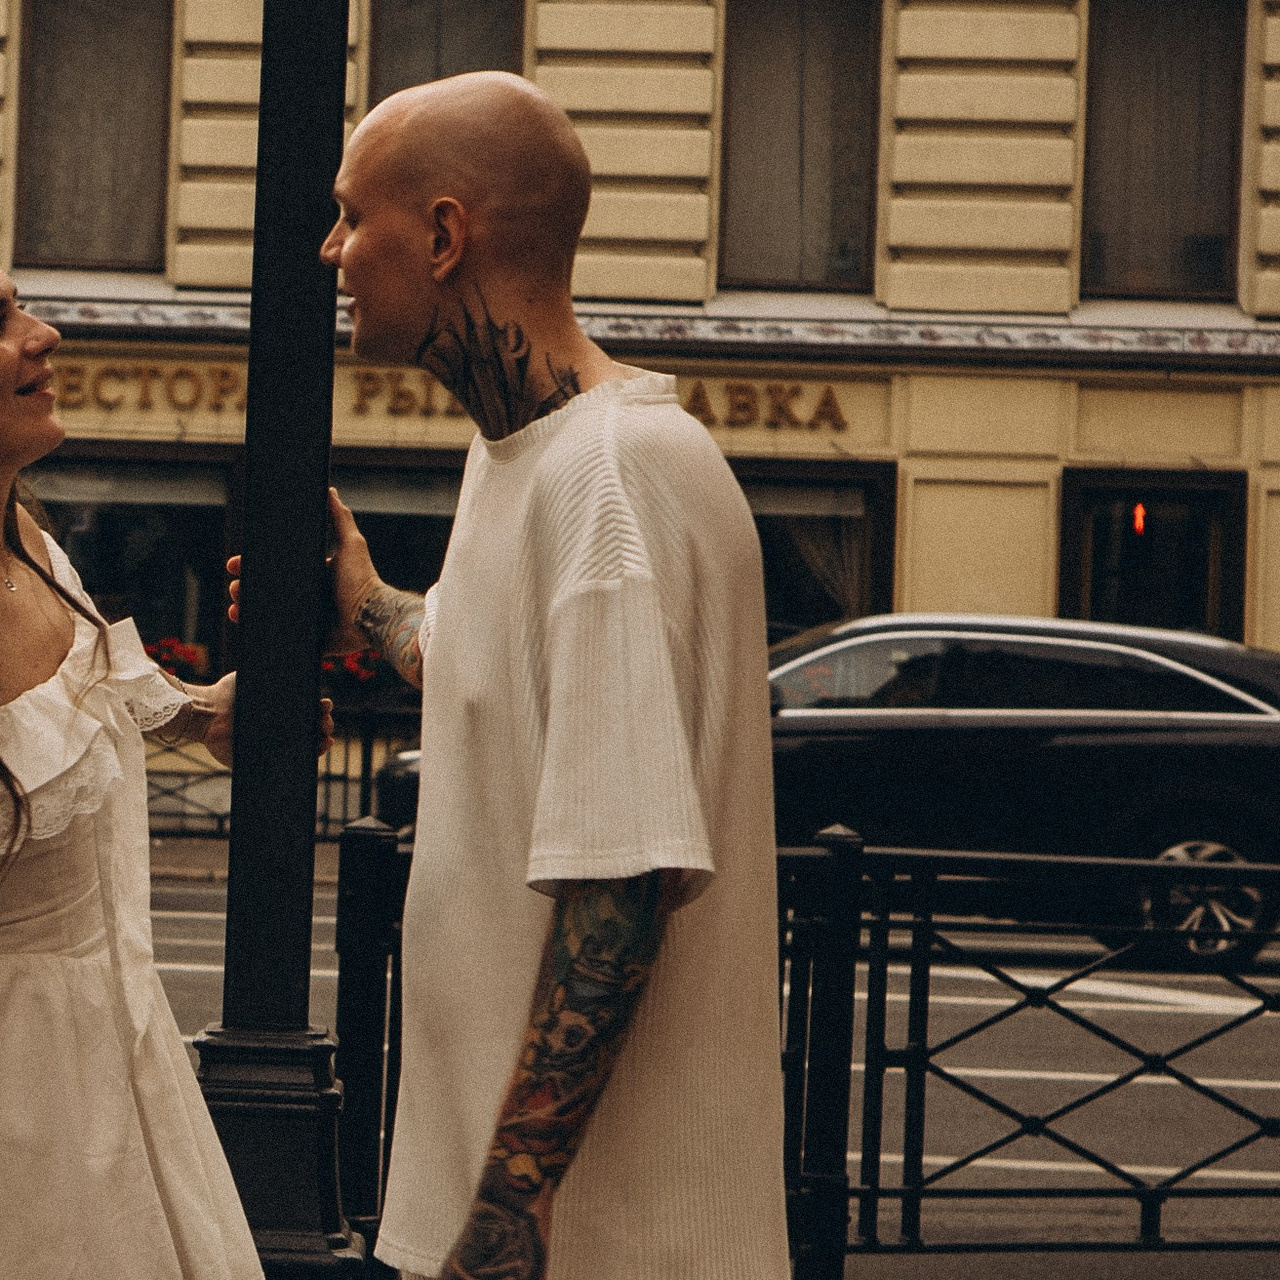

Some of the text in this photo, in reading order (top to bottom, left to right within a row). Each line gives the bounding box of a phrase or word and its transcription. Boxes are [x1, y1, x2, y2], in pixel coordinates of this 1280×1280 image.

[55, 366, 848, 431] ЕСТОР РЫ АВКА
